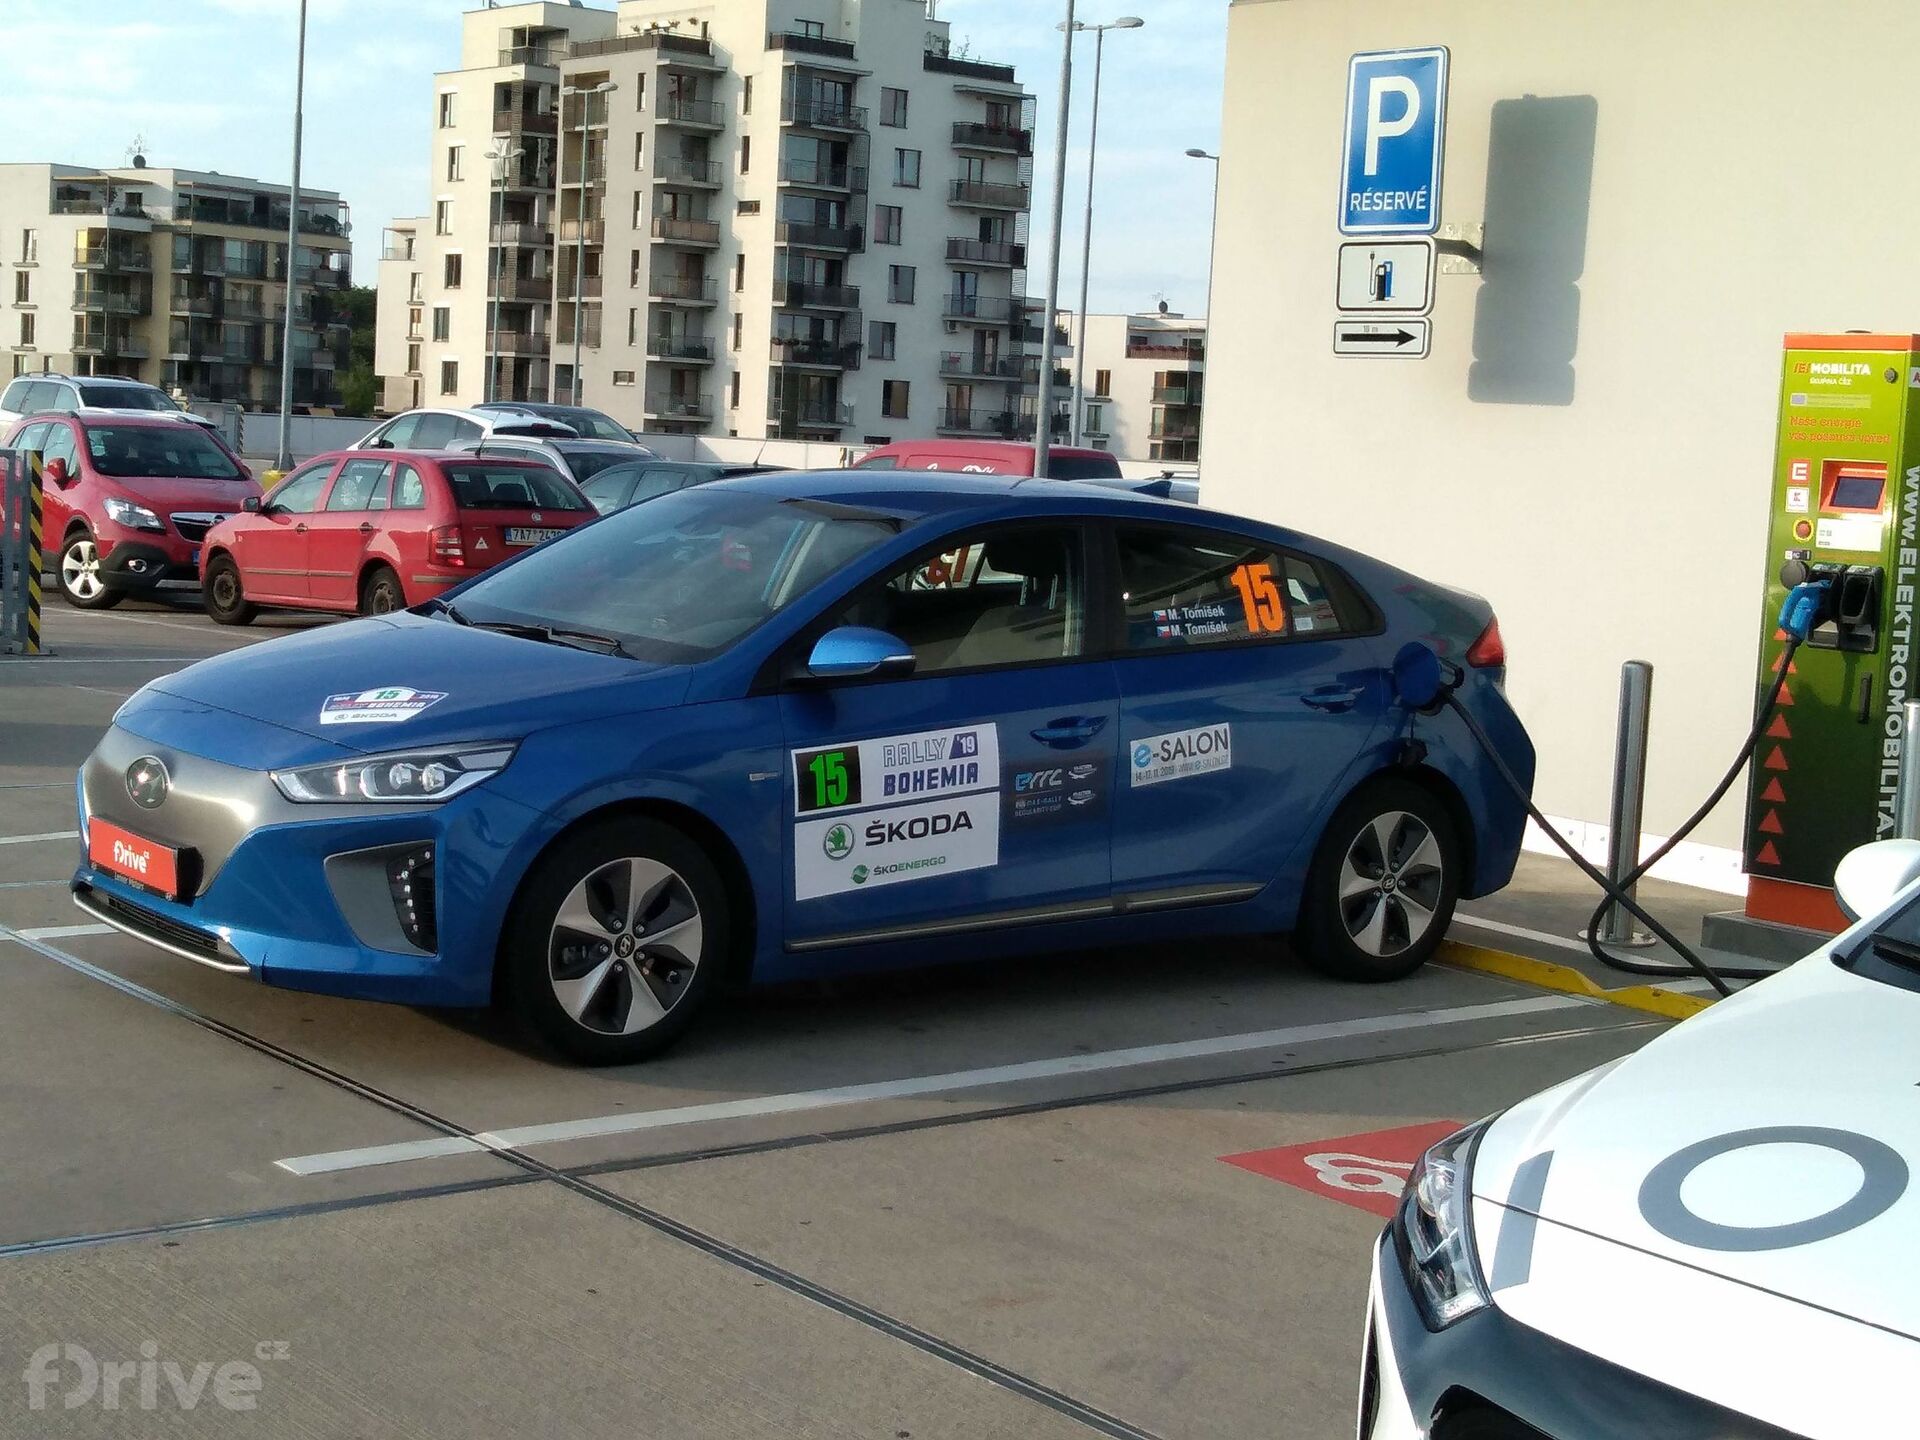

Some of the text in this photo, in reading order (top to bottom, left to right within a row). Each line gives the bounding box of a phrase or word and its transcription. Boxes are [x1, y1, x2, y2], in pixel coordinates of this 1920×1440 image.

[1364, 76, 1420, 176] P
[1350, 185, 1427, 212] RÉSERVÉ
[1167, 608, 1181, 621] M.
[1230, 563, 1285, 633] 15
[1171, 625, 1184, 637] M.
[883, 737, 947, 768] RALLY
[809, 751, 848, 808] 15
[883, 762, 979, 797] BOHEMIA
[865, 810, 973, 847] ŠKODA
[873, 855, 946, 877] ŠKOENERGO
